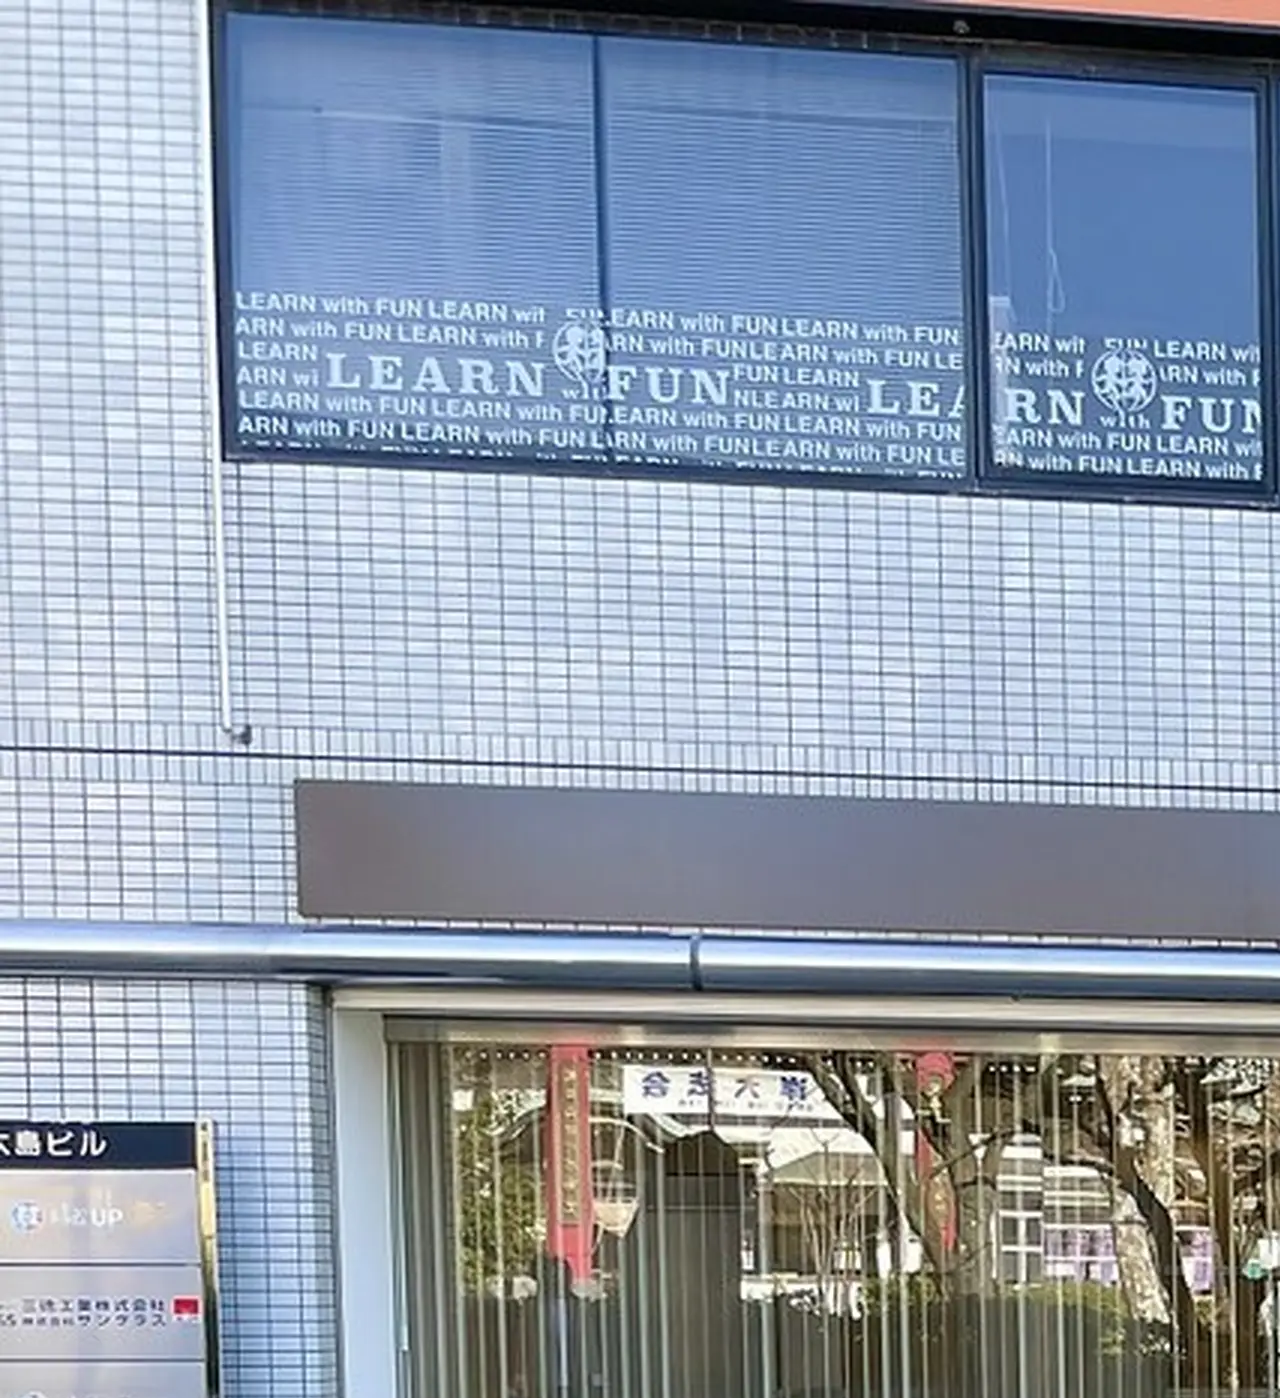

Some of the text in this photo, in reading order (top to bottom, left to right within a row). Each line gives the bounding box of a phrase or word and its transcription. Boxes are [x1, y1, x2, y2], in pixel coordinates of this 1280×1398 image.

[235, 292, 958, 345] LEARN with FUN LEARN with FUN LEARN with FUN
[238, 341, 318, 361] LEARN
[290, 320, 929, 368] with FUN LEARN with FUN LEARN with FUN
[1154, 340, 1225, 362] LEARN
[326, 353, 729, 404] LEARN FUN
[733, 364, 859, 387] FUN LEARN
[1026, 360, 1245, 386] with with
[751, 390, 828, 411] LEARN
[1003, 388, 1085, 425] RN
[239, 389, 961, 441] LEARN with FUN LEARN with with FUN LEARN with FUN
[294, 418, 931, 464] with FUN LEARN with FUN with FUN LEARN with FUN
[1058, 431, 1228, 455] with FUN LEARN
[1029, 454, 1249, 479] with FUN LEARN with
[91, 1208, 124, 1227] UP
